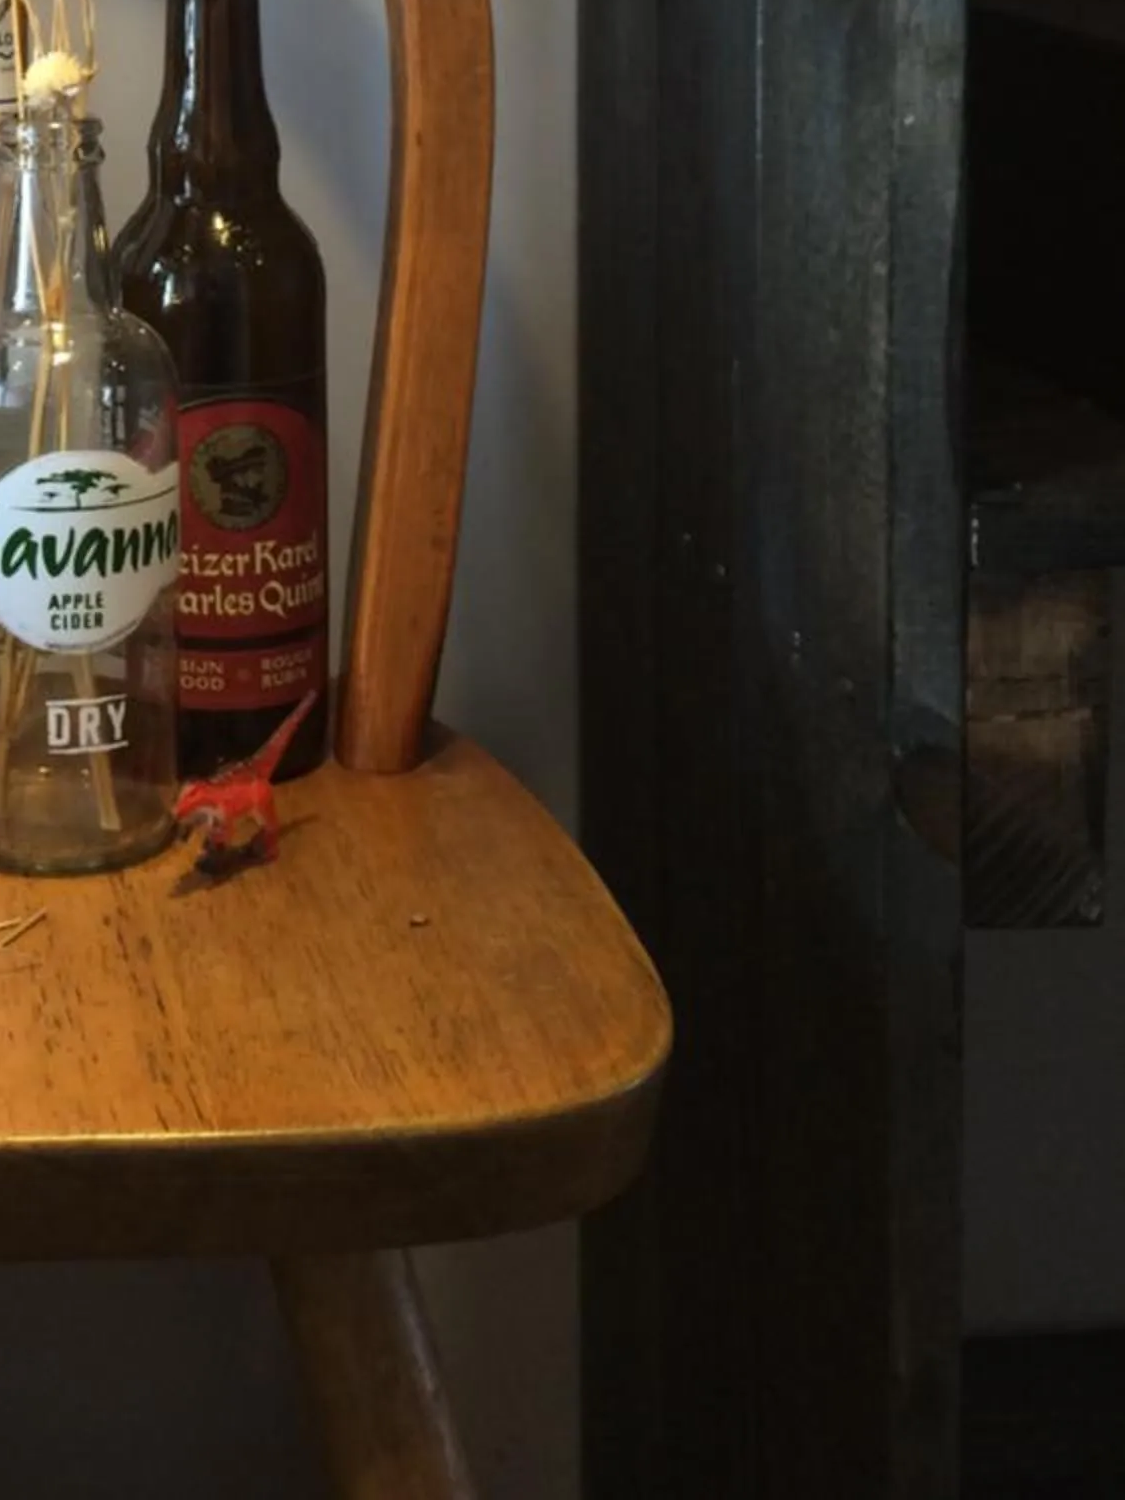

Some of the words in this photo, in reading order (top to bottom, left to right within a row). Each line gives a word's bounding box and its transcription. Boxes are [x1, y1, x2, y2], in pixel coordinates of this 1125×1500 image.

[48, 591, 105, 611] APPLE
[50, 612, 104, 631] CIDER
[47, 701, 126, 747] DRY
